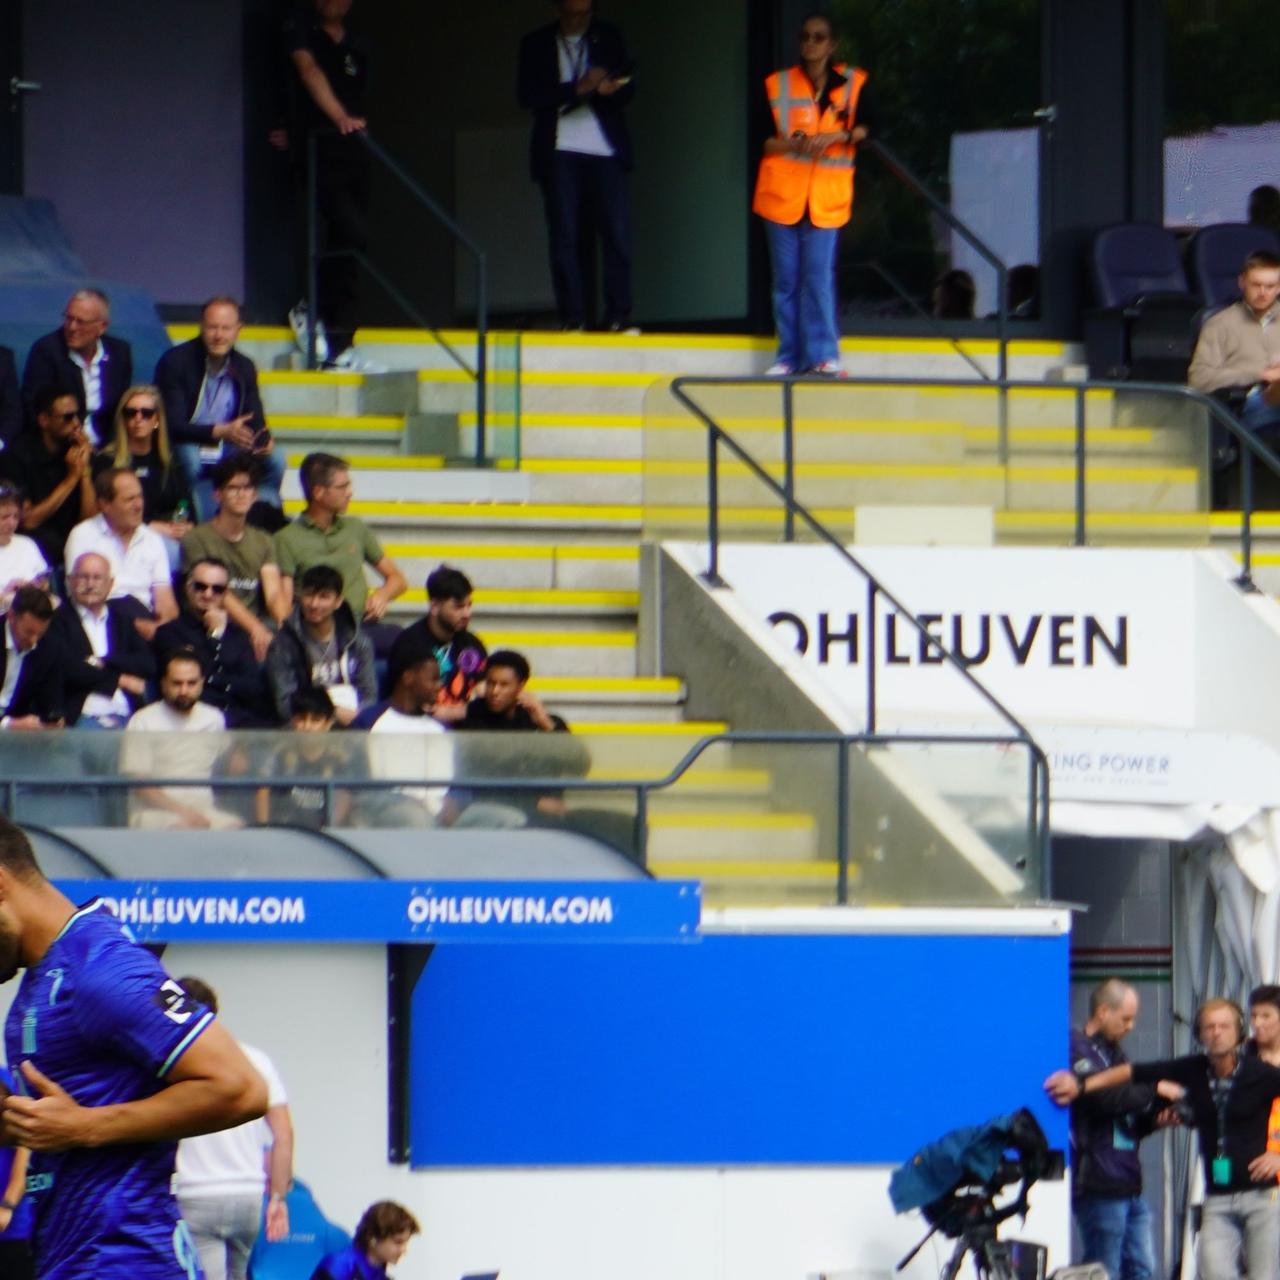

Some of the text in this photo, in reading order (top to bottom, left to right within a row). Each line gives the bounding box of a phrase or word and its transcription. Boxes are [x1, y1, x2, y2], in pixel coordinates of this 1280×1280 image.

[886, 612, 1128, 668] LEUVEN
[1046, 753, 1169, 774] ING POWER
[407, 896, 613, 925] OHLEUVEN.COM
